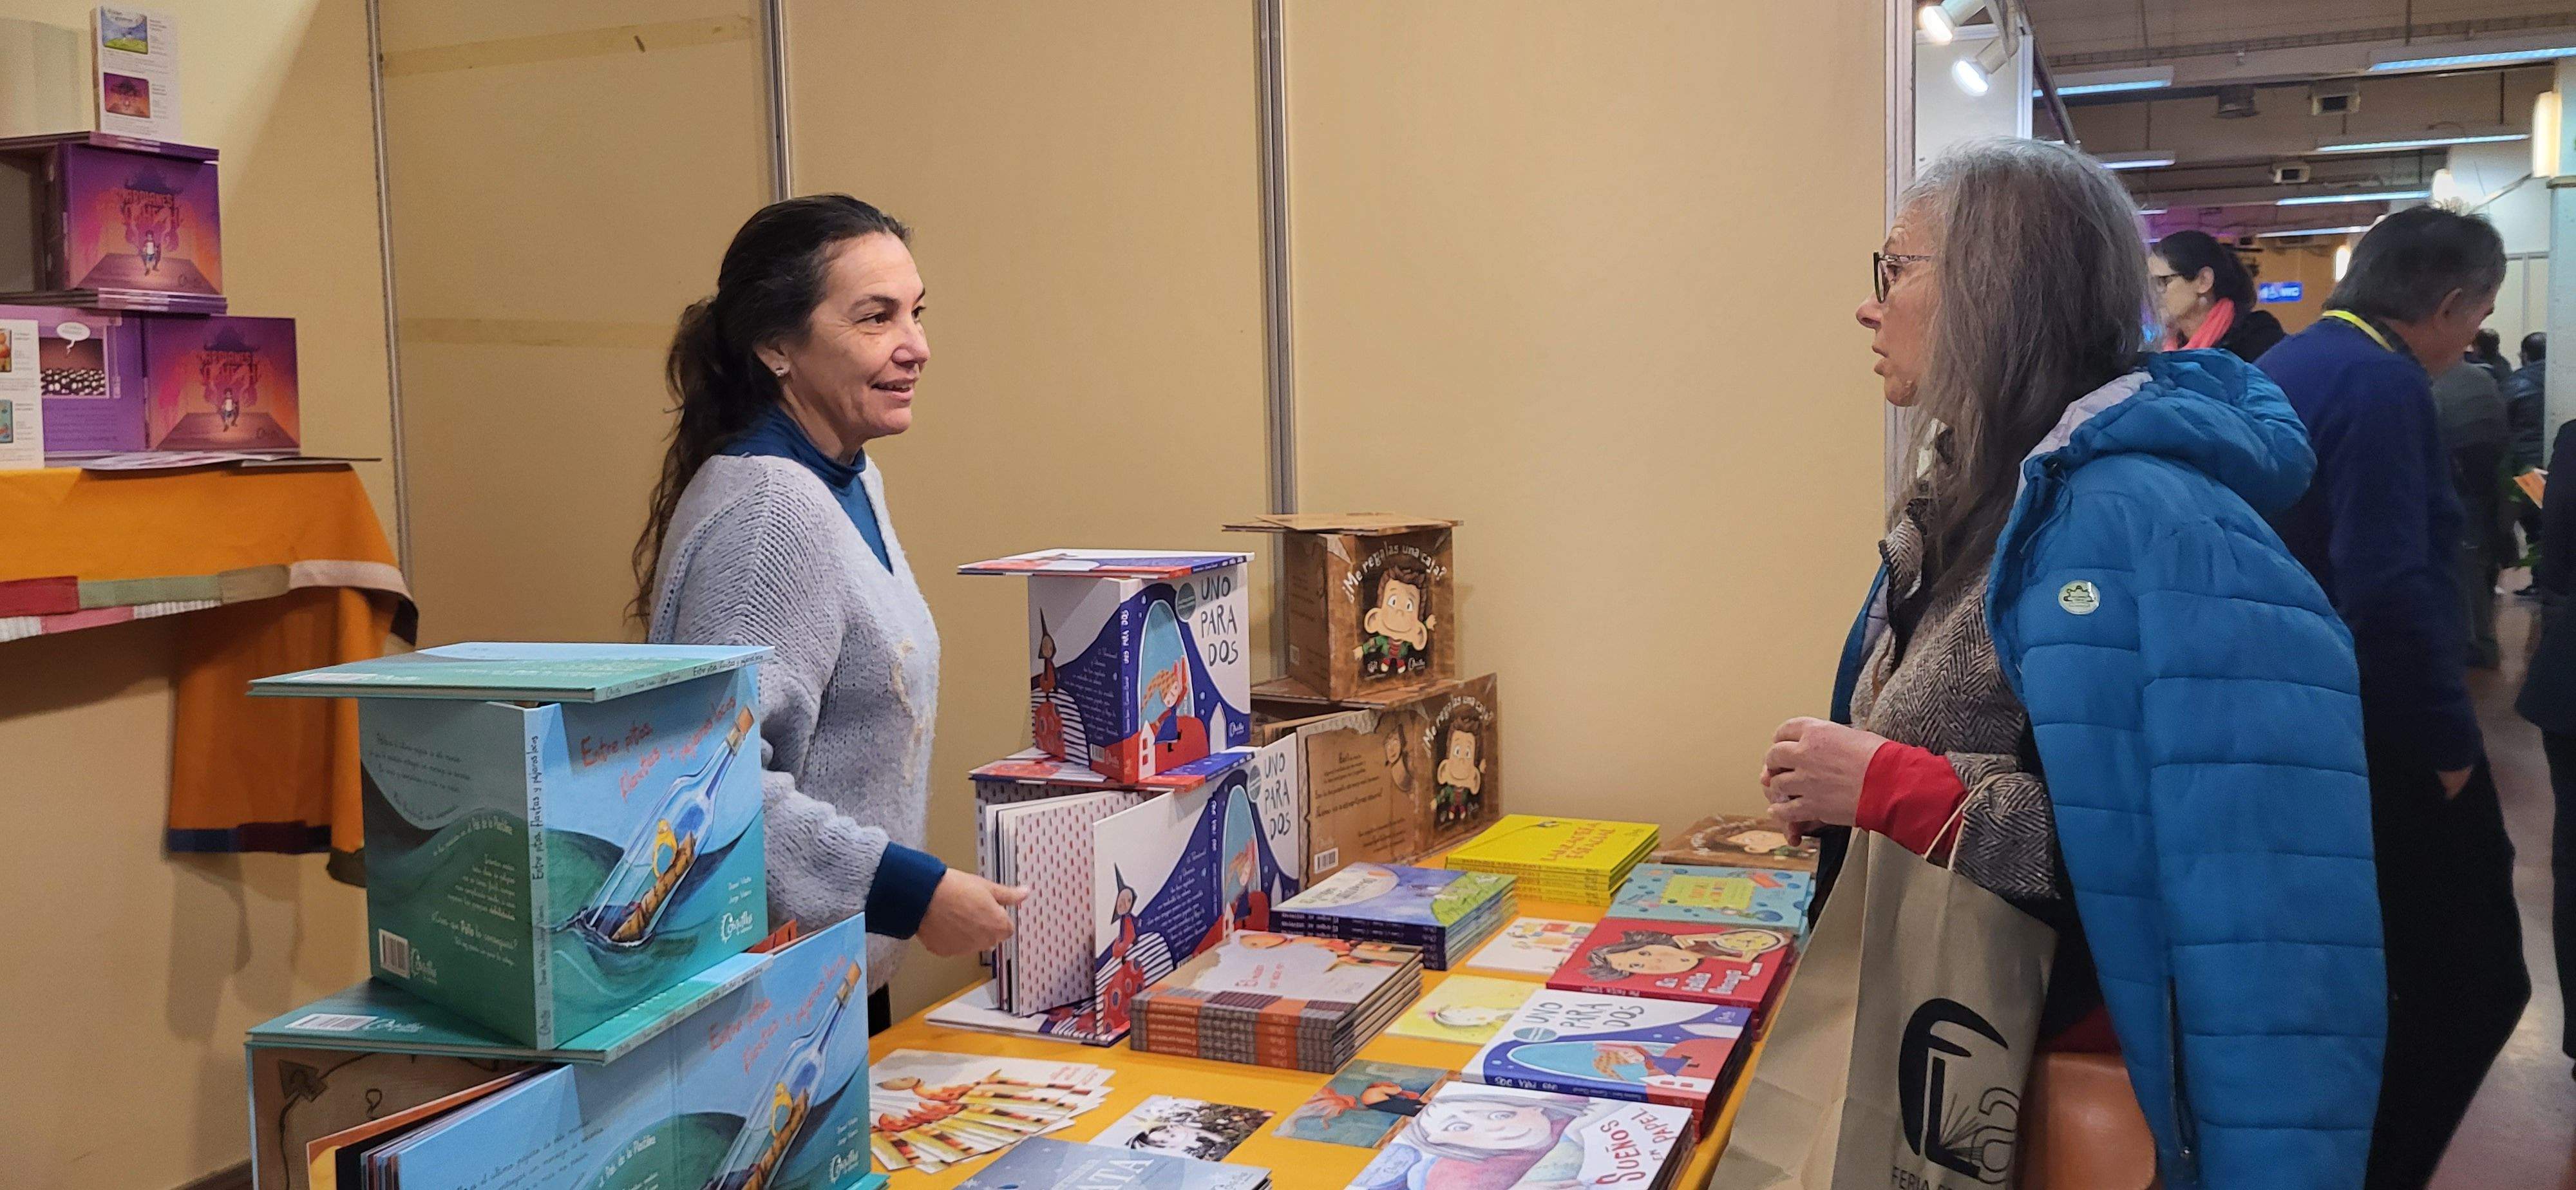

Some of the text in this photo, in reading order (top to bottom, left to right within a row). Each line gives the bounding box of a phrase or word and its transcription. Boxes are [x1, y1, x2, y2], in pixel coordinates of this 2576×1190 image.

[1363, 541, 1399, 572] regalas
[1403, 545, 1419, 558] una
[1421, 552, 1448, 580] caja?
[1202, 575, 1231, 601] UNO
[1201, 604, 1237, 638] PARA
[1209, 639, 1238, 666] DOS
[526, 735, 538, 755] locos
[582, 736, 619, 767] Entre
[1264, 752, 1285, 778] UNO
[1265, 780, 1290, 814] PARA
[529, 796, 543, 827] flautas
[1270, 812, 1291, 840] DOS
[531, 856, 544, 880] Entre
[1524, 1002, 1563, 1023] UNO
[1560, 1003, 1613, 1028] PARA
[1603, 1005, 1644, 1027] DOS
[1495, 1076, 1513, 1088] DOS
[1631, 1108, 1678, 1144] PAPEL
[1596, 1120, 1646, 1184] SUEÑOS
